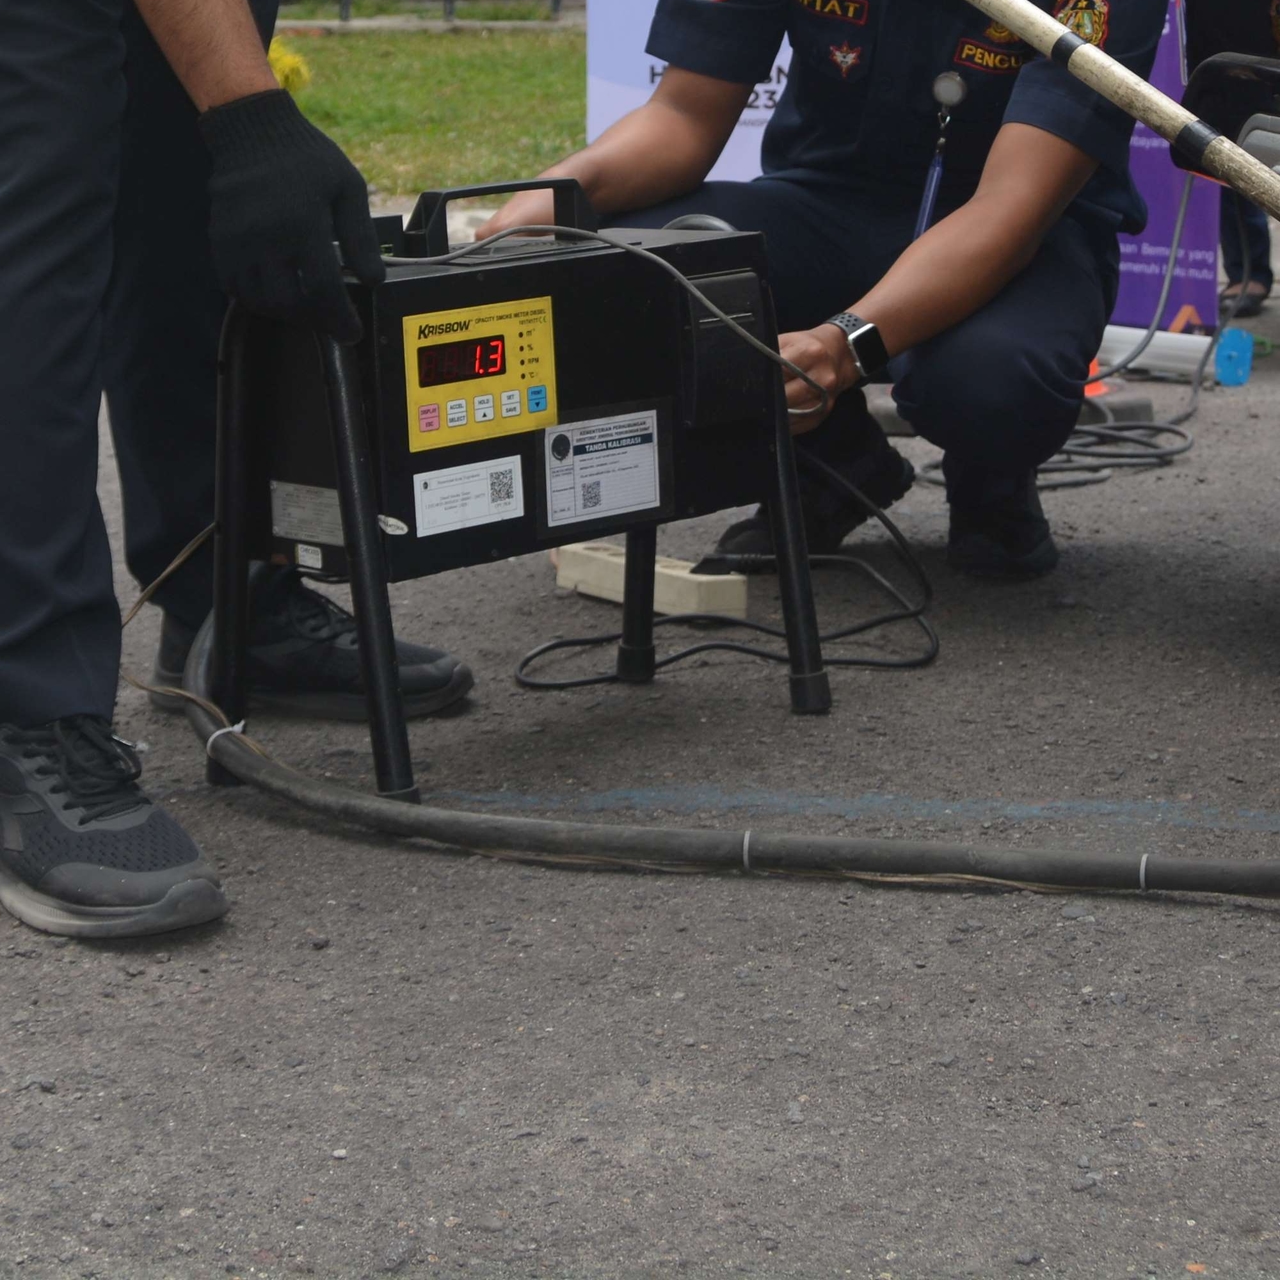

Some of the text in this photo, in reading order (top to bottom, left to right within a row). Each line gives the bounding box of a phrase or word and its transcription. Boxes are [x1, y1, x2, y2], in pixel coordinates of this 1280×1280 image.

[961, 44, 1022, 68] PENGU
[745, 89, 777, 109] 23
[1188, 248, 1215, 263] yang
[417, 319, 470, 340] KRISBOW
[474, 315, 495, 324] OPACITY
[496, 313, 513, 321] SMOKE
[475, 340, 503, 374] 1.3
[527, 357, 540, 365] RPM
[478, 398, 490, 406] HOLD
[448, 415, 466, 423] SELECT
[585, 437, 642, 452] TANDA KALIBRASI
